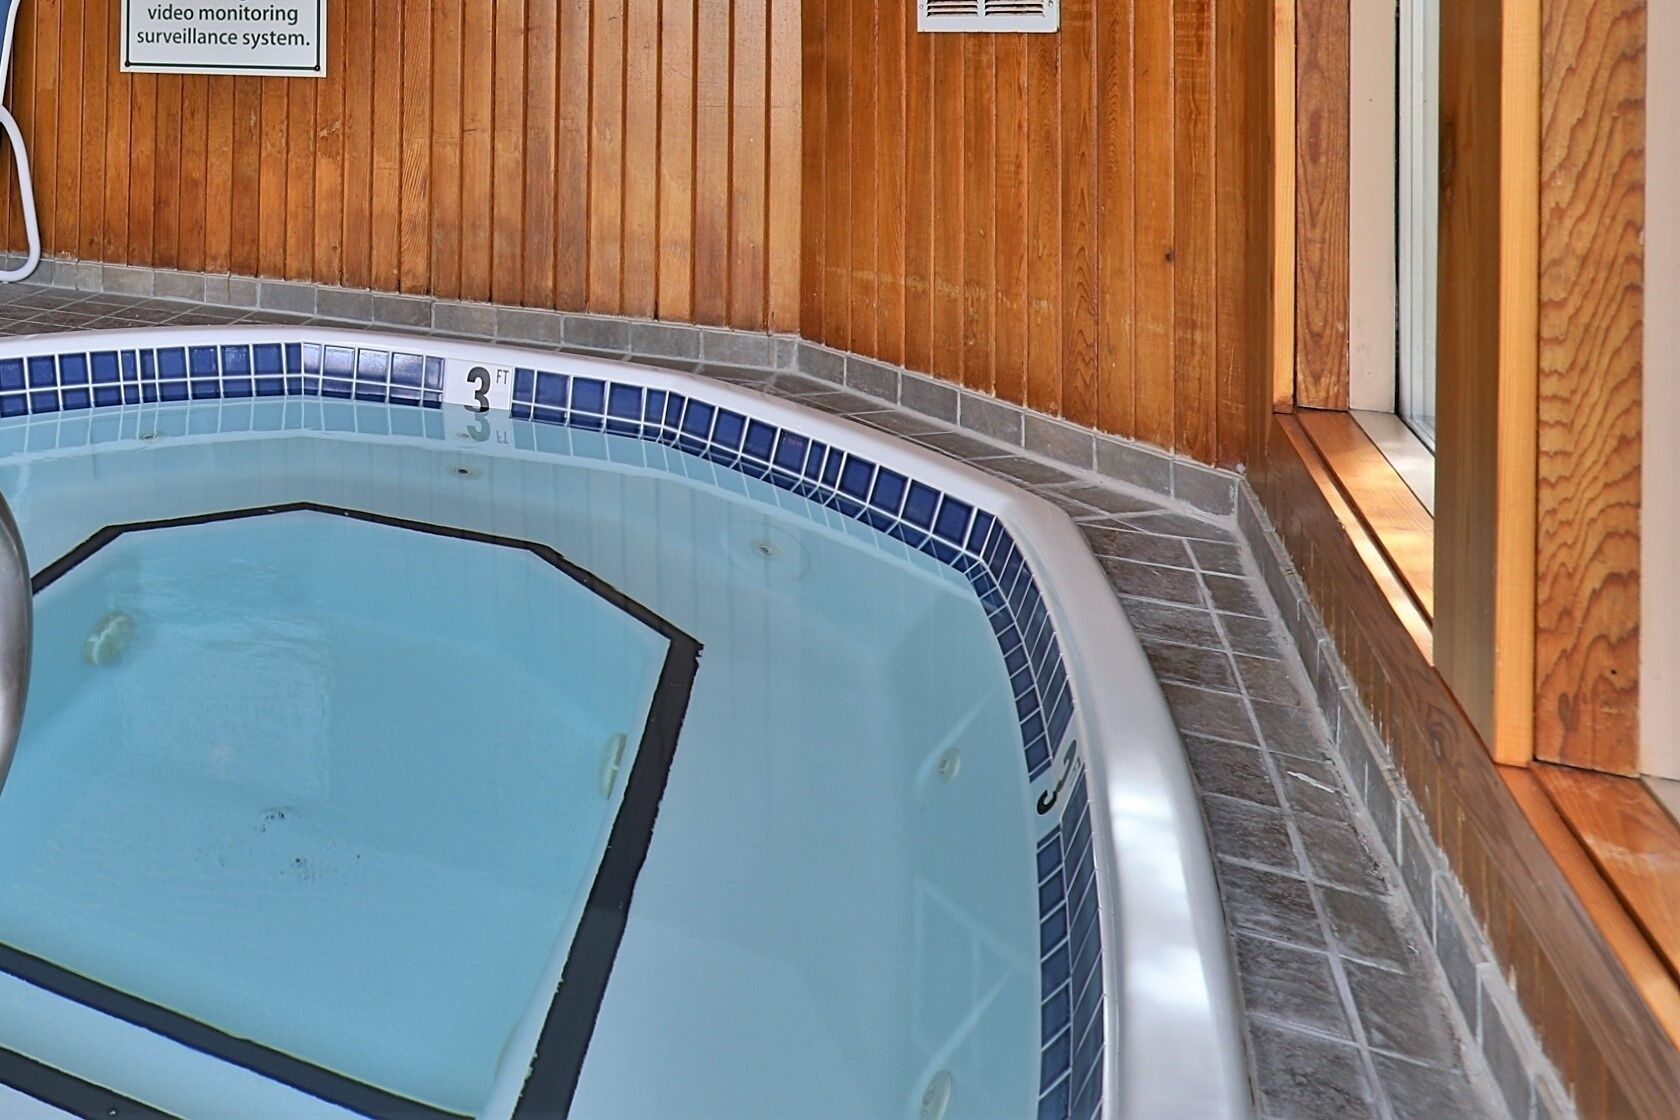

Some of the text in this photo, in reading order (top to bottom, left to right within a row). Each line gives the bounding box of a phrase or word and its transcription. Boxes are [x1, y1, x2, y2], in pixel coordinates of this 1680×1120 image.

[148, 4, 299, 26] video monitoring
[137, 28, 310, 50] surveillance system.
[466, 366, 510, 413] 3 FT
